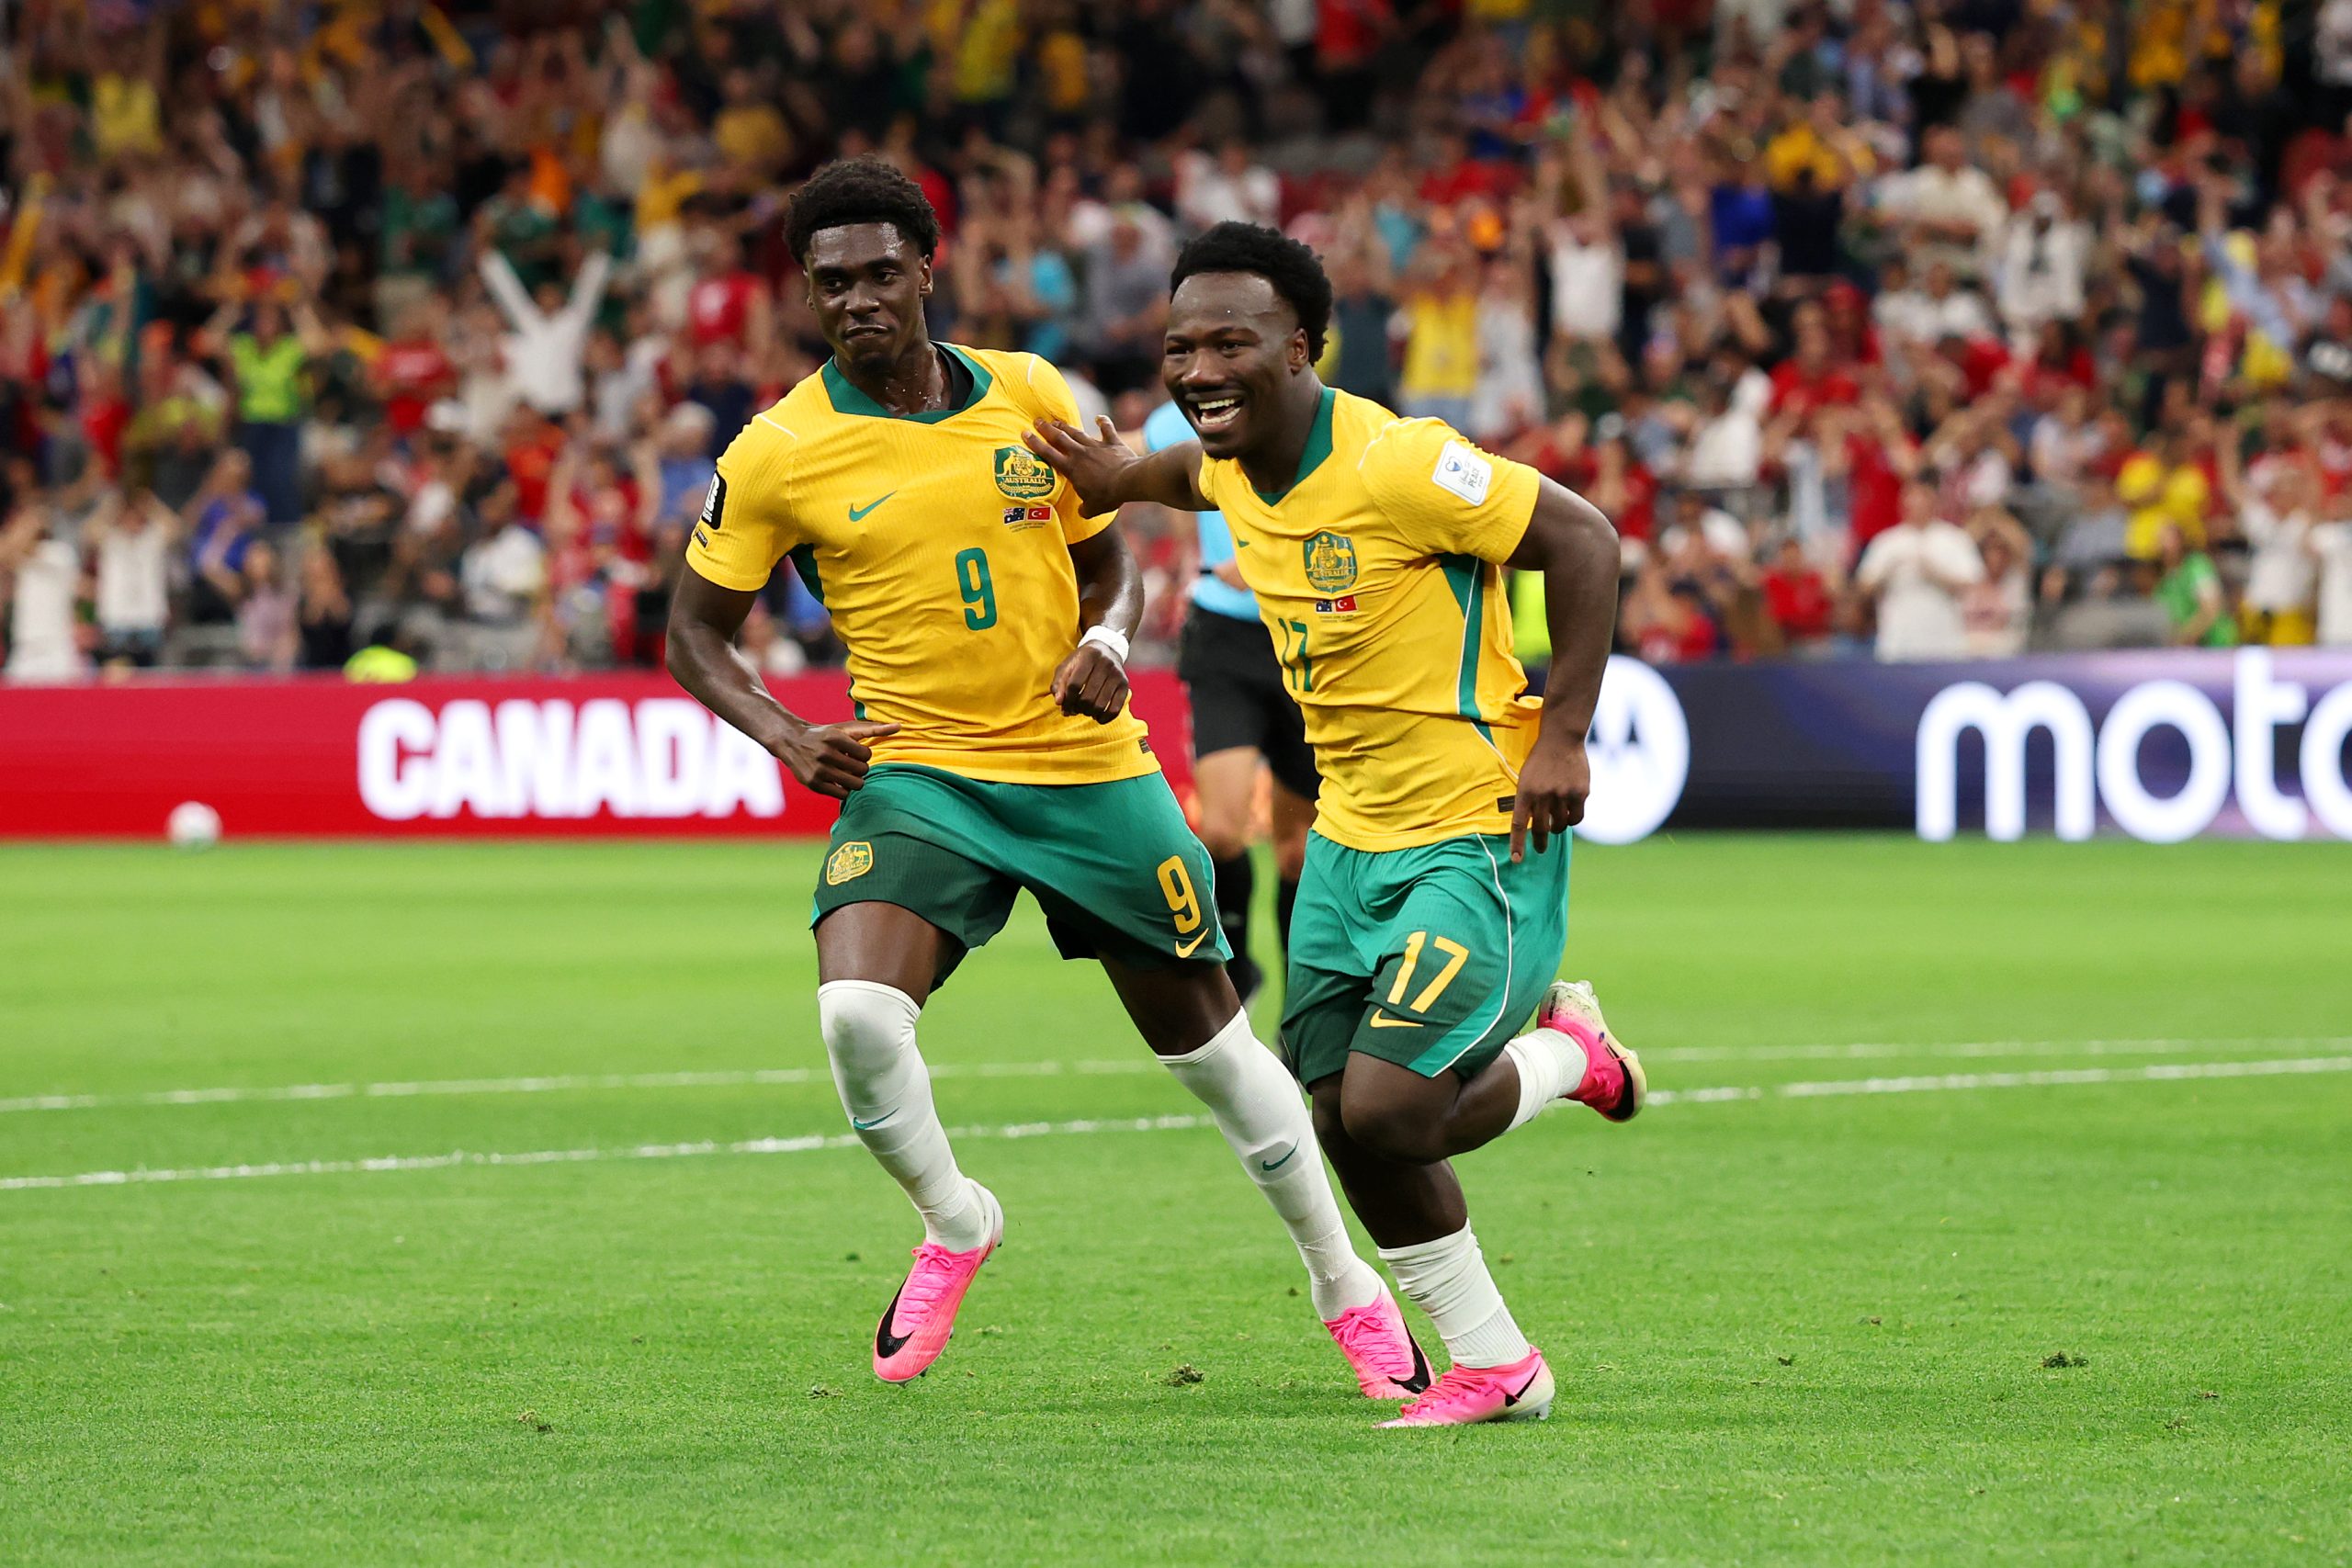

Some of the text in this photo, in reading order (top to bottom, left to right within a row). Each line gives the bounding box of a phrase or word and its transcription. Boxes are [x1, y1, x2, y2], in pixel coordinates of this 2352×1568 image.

[1004, 477, 1046, 485] AUSTRALIA
[955, 547, 998, 631] 9
[1278, 616, 1314, 692] 17
[357, 698, 786, 820] CANADA
[1157, 855, 1201, 933] 9
[1387, 931, 1470, 1013] 17
